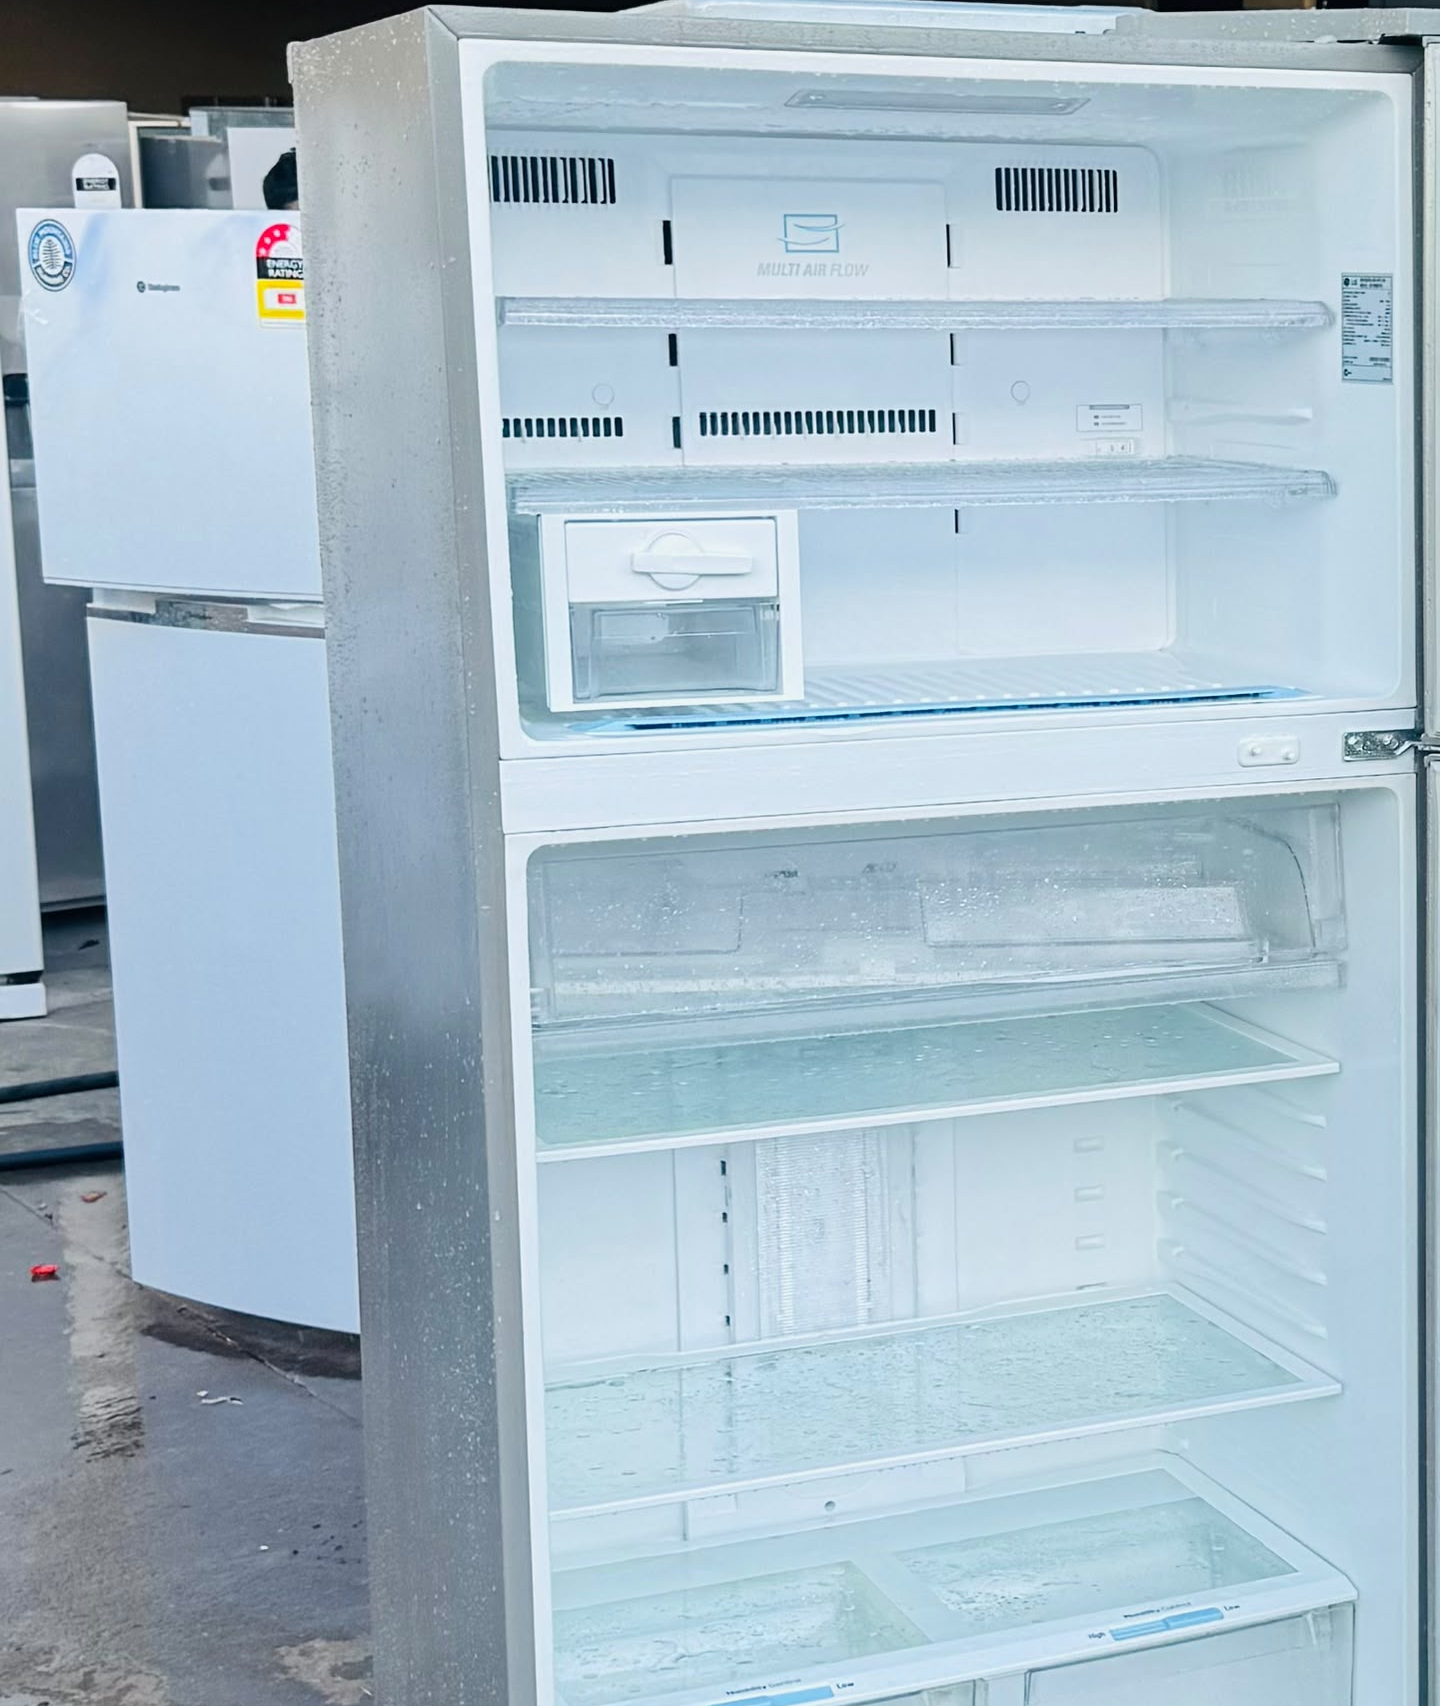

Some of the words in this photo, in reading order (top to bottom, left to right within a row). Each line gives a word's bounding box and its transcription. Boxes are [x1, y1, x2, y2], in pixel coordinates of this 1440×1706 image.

[266, 259, 304, 270] ENERGY
[757, 262, 801, 277] MULTI
[802, 262, 827, 277] AIR
[829, 262, 870, 277] FLOW
[1088, 1631, 1106, 1640] High
